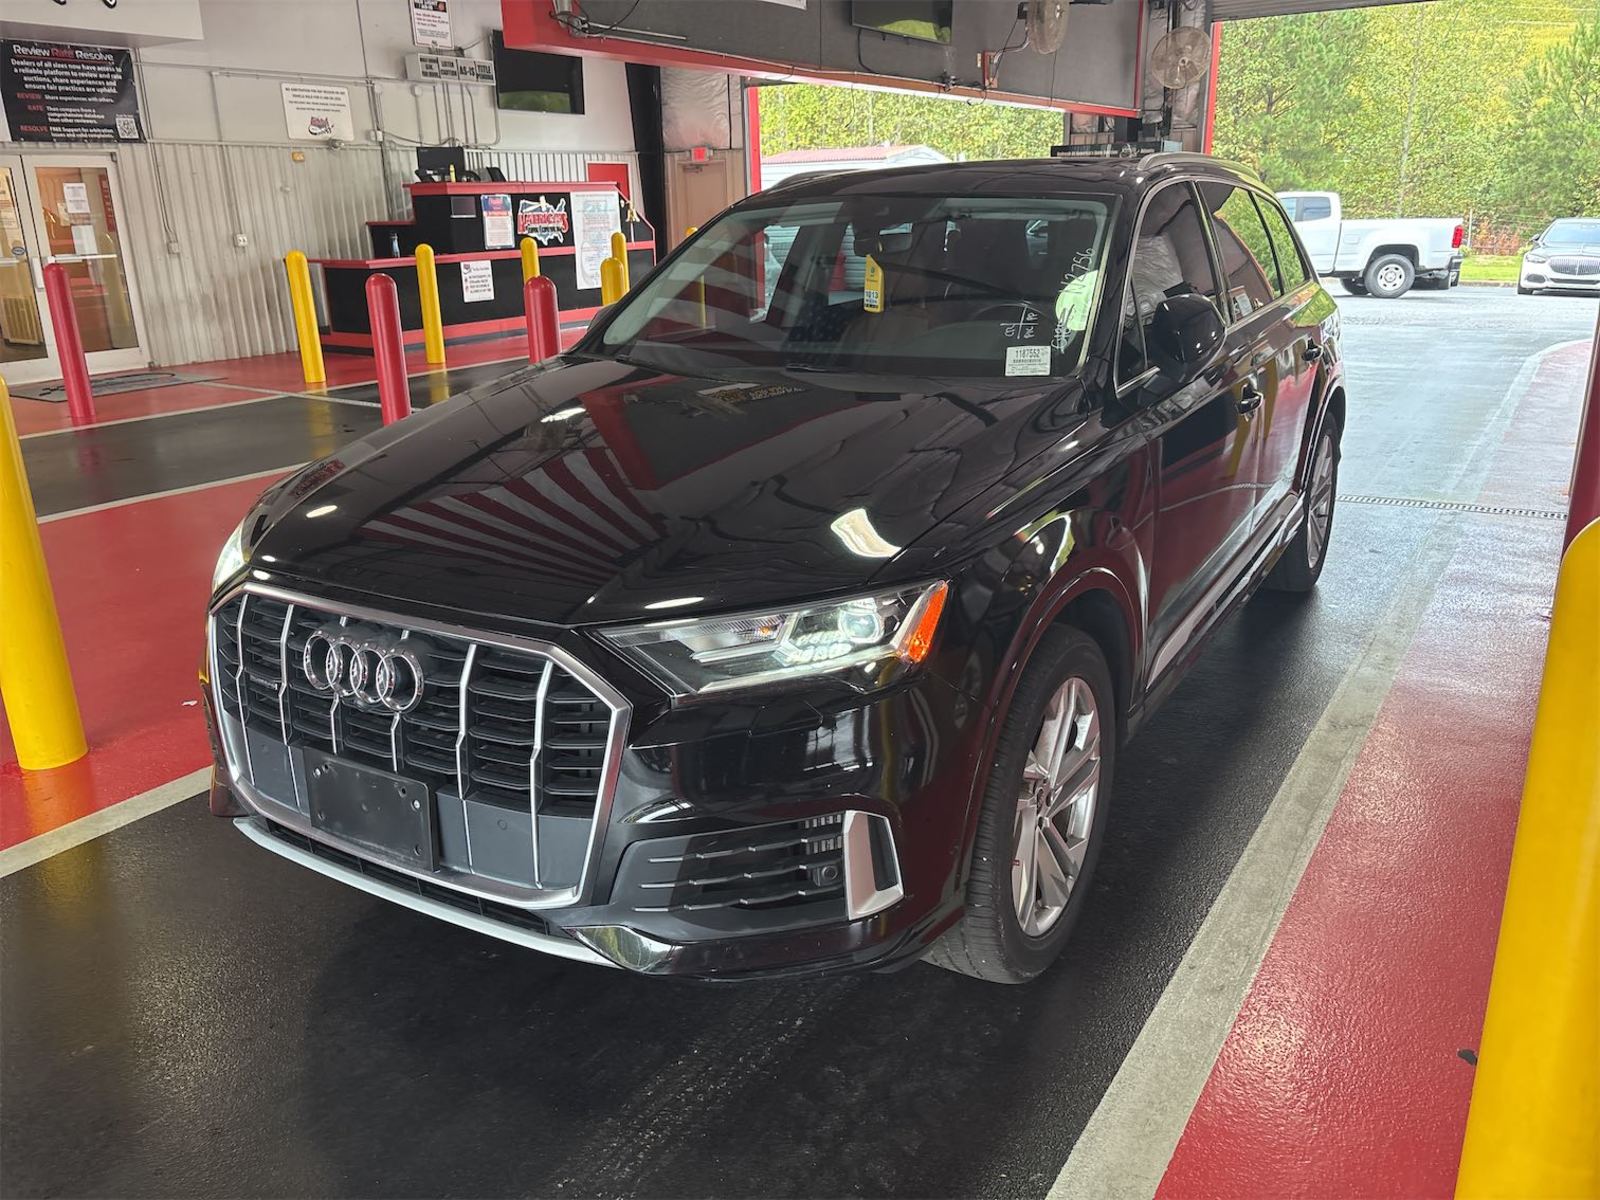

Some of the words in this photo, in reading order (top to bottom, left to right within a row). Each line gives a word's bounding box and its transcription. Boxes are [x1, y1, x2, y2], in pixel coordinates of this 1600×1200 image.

[13, 44, 50, 56] Review
[75, 50, 114, 61] Resolve
[11, 58, 35, 67] Dealers
[44, 69, 70, 77] platform
[1015, 348, 1040, 359] 1187552
